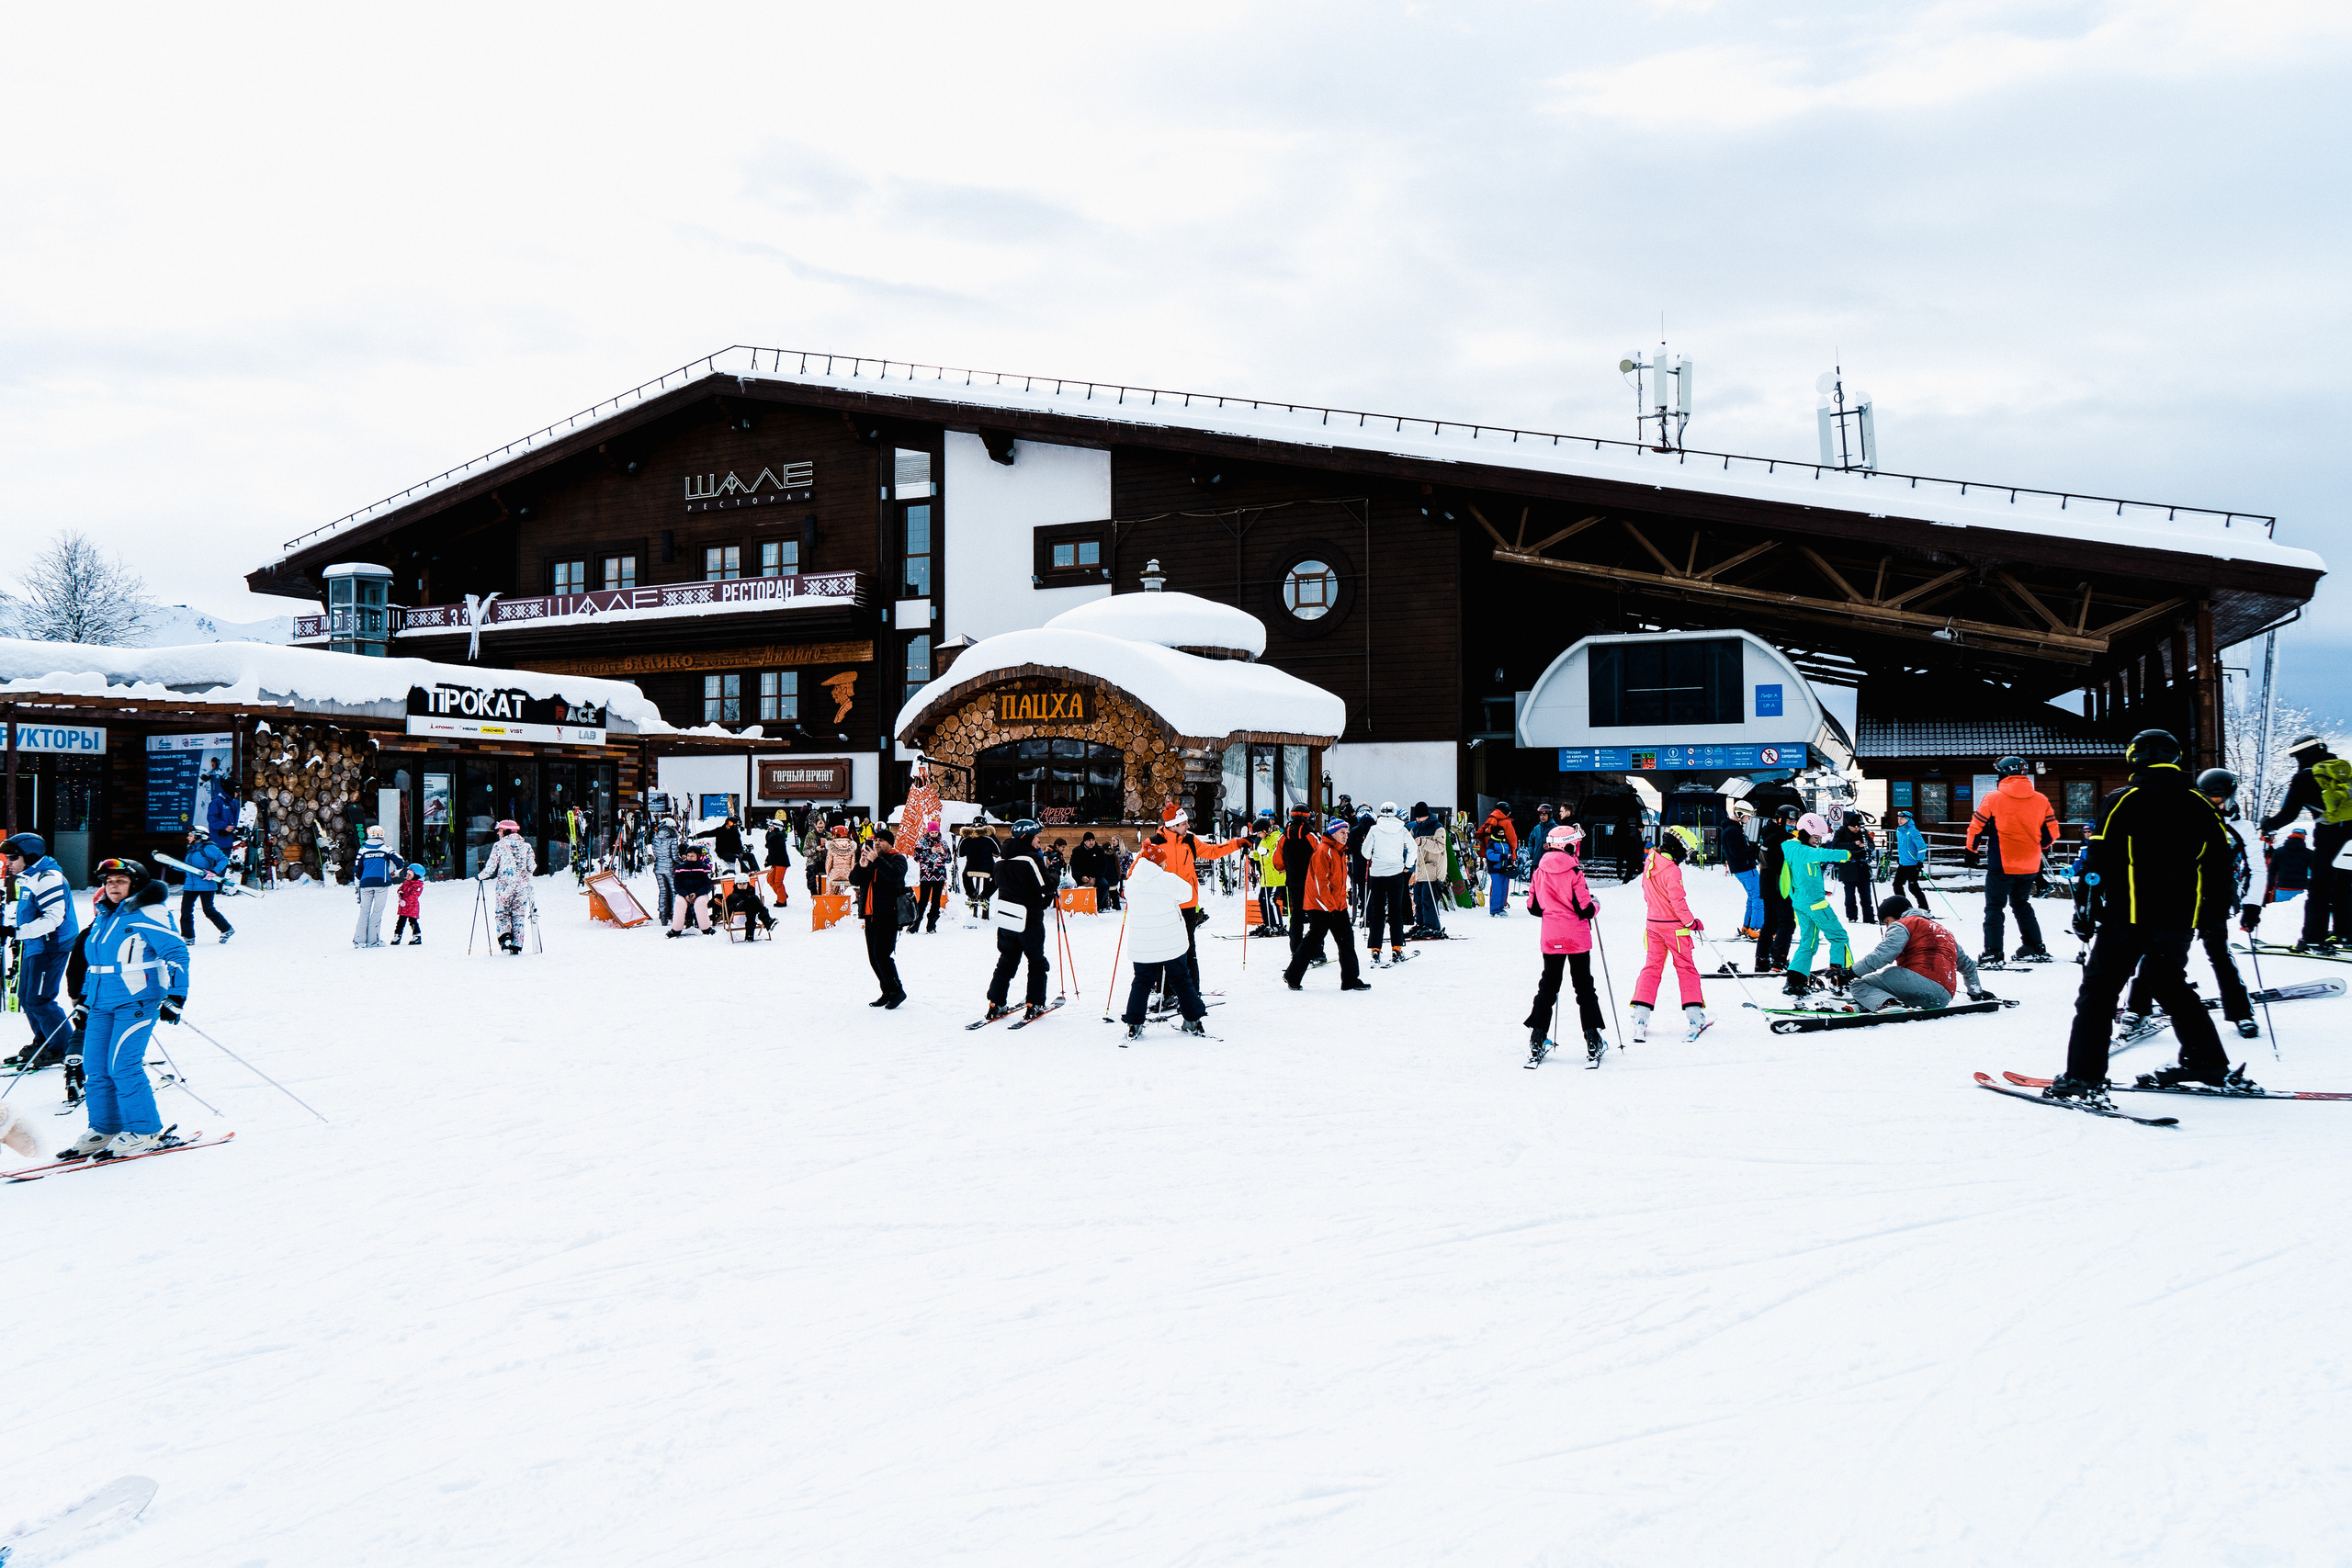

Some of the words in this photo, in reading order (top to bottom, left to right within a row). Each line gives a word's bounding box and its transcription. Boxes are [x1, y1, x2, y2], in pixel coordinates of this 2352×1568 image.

[687, 491, 810, 512] РЕСТОРАН
[722, 579, 795, 603] РЕСТОРАН
[573, 663, 616, 673] РЕСТОРАН
[625, 656, 695, 670] ВАЛИКО
[428, 688, 526, 719] ПРОКАТ
[1001, 693, 1083, 722] ПАЦХА
[555, 705, 597, 724] RACE
[578, 729, 597, 740] LAB
[773, 769, 804, 782] ГОРНЫЙ
[805, 770, 834, 782] ПРИЮТ
[1040, 807, 1077, 818] APEROL
